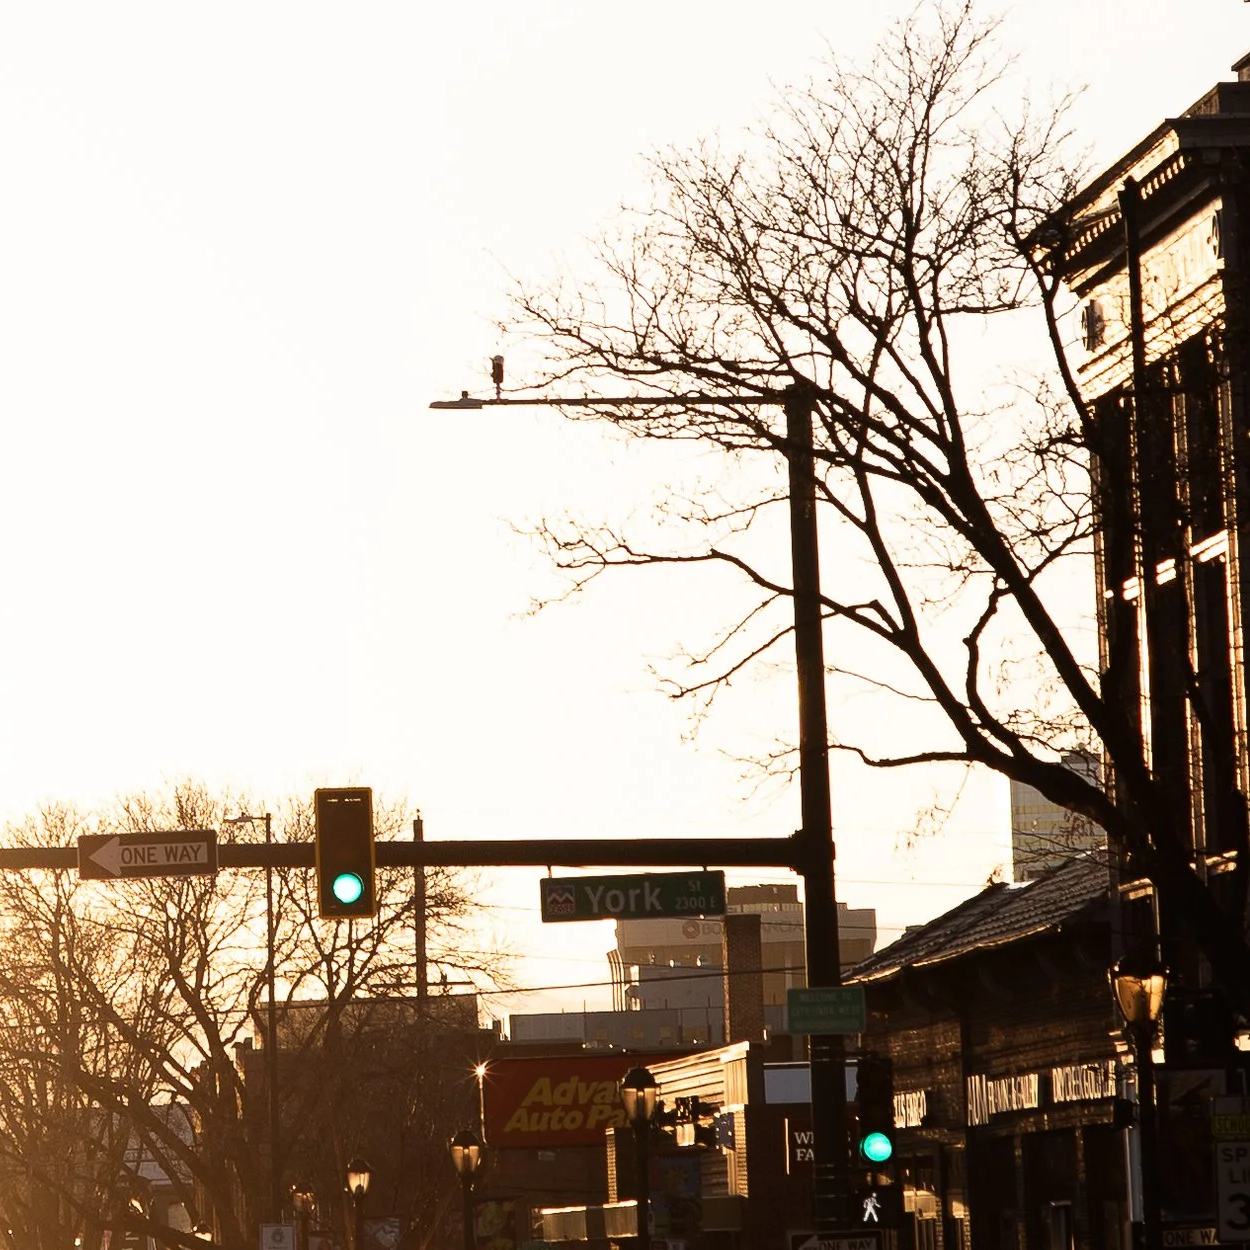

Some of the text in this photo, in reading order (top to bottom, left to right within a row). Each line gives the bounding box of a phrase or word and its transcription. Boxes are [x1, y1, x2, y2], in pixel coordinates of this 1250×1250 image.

[121, 844, 202, 865] ONE WAY
[688, 881, 701, 892] St
[584, 881, 663, 914] York
[675, 896, 717, 910] 2300 E
[520, 1076, 621, 1107] Adva
[503, 1106, 584, 1132] Auto
[1215, 1116, 1250, 1133] SCHO
[1225, 1193, 1250, 1231] 3
[847, 1239, 873, 1250] WAY
[1165, 1229, 1219, 1245] ONE WA
